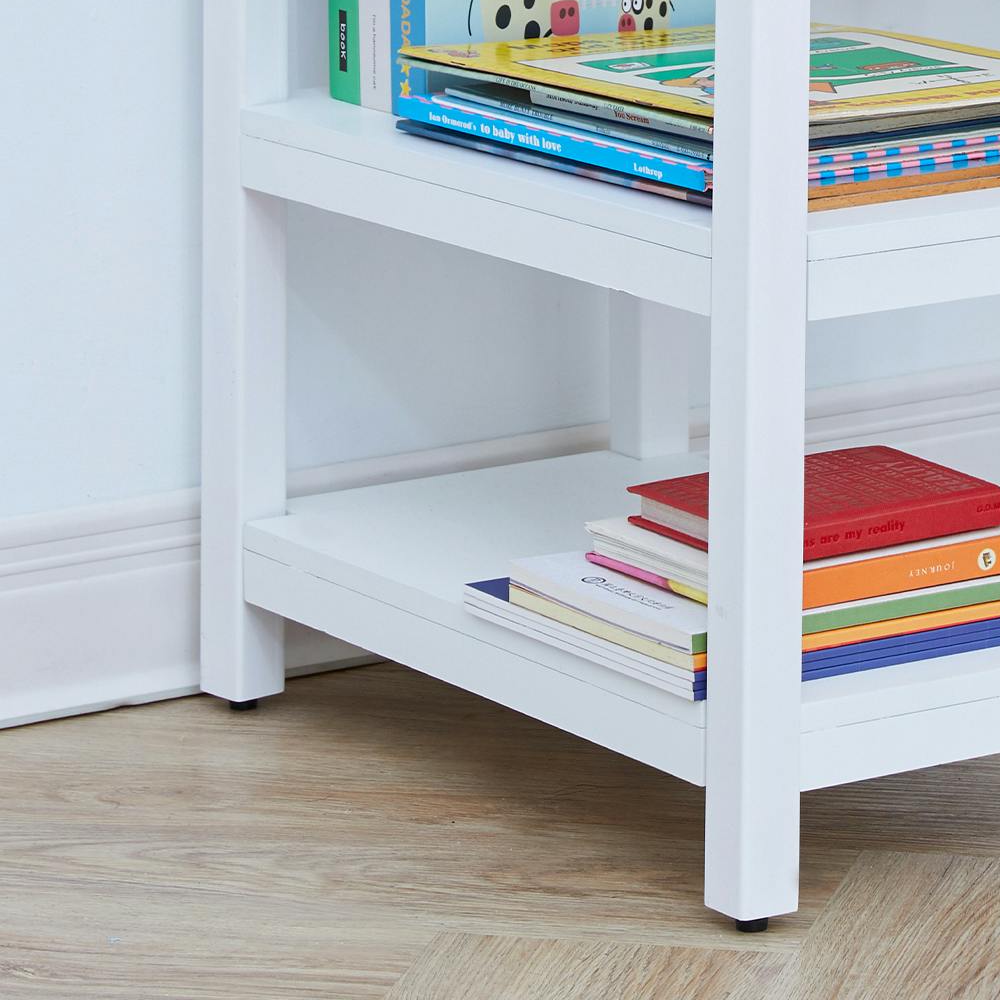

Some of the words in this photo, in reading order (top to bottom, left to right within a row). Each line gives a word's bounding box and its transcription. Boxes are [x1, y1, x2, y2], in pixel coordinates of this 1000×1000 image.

[340, 23, 348, 60] book
[480, 123, 491, 135] to
[492, 125, 515, 143] baby
[517, 132, 540, 148] with
[542, 137, 562, 153] love
[820, 533, 840, 545] are
[845, 528, 863, 541] my
[868, 520, 906, 537] reality
[909, 561, 955, 578] JOURNEY
